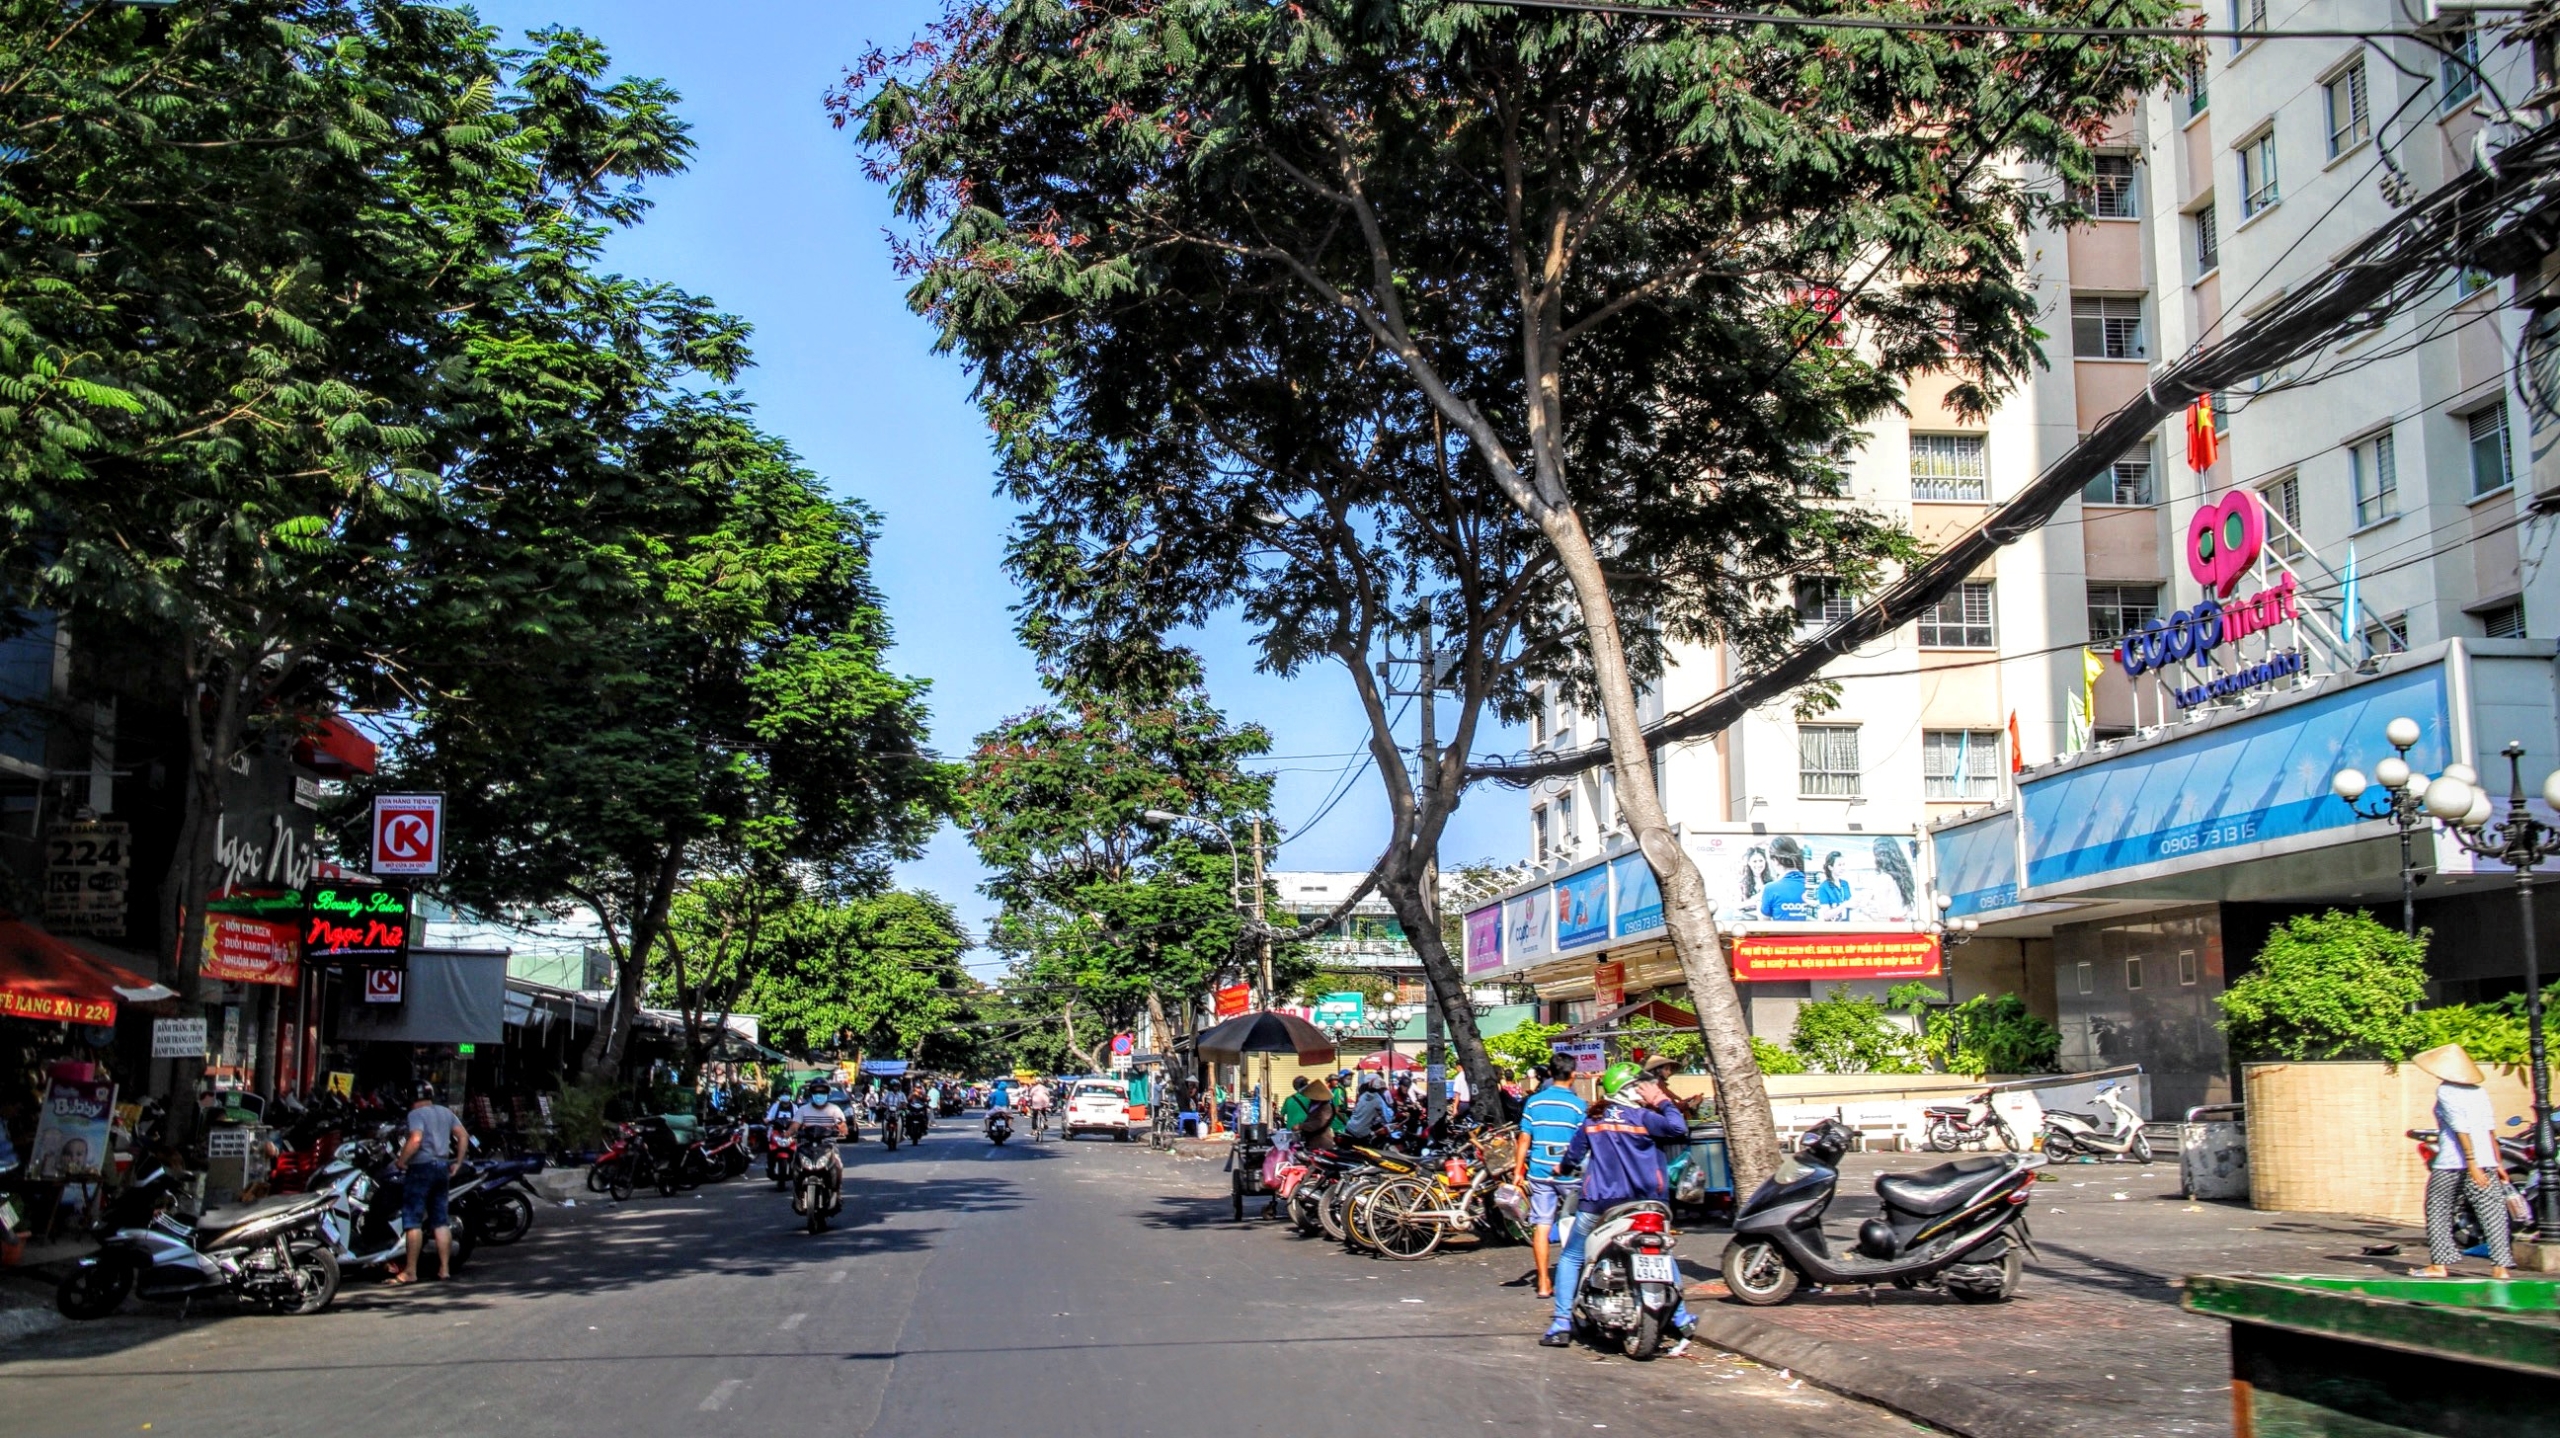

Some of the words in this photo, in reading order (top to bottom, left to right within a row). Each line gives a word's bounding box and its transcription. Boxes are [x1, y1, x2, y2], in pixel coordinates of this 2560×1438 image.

[2160, 833, 2200, 854] 0903
[2202, 828, 2221, 846] 73
[2224, 826, 2238, 842] 13
[2241, 822, 2256, 839] 15
[52, 840, 119, 865] 224
[313, 890, 363, 917] Beauty
[366, 893, 405, 913] Salon
[1980, 894, 2006, 909] 0903
[307, 918, 363, 954] Ngọc
[364, 920, 403, 946] Nữ
[1624, 919, 1642, 933] 0903
[1642, 916, 1651, 929] 73
[15, 995, 52, 1014] RANG
[53, 998, 83, 1018] XAY
[84, 1004, 111, 1021] 224
[1471, 1083, 1480, 1095] B
